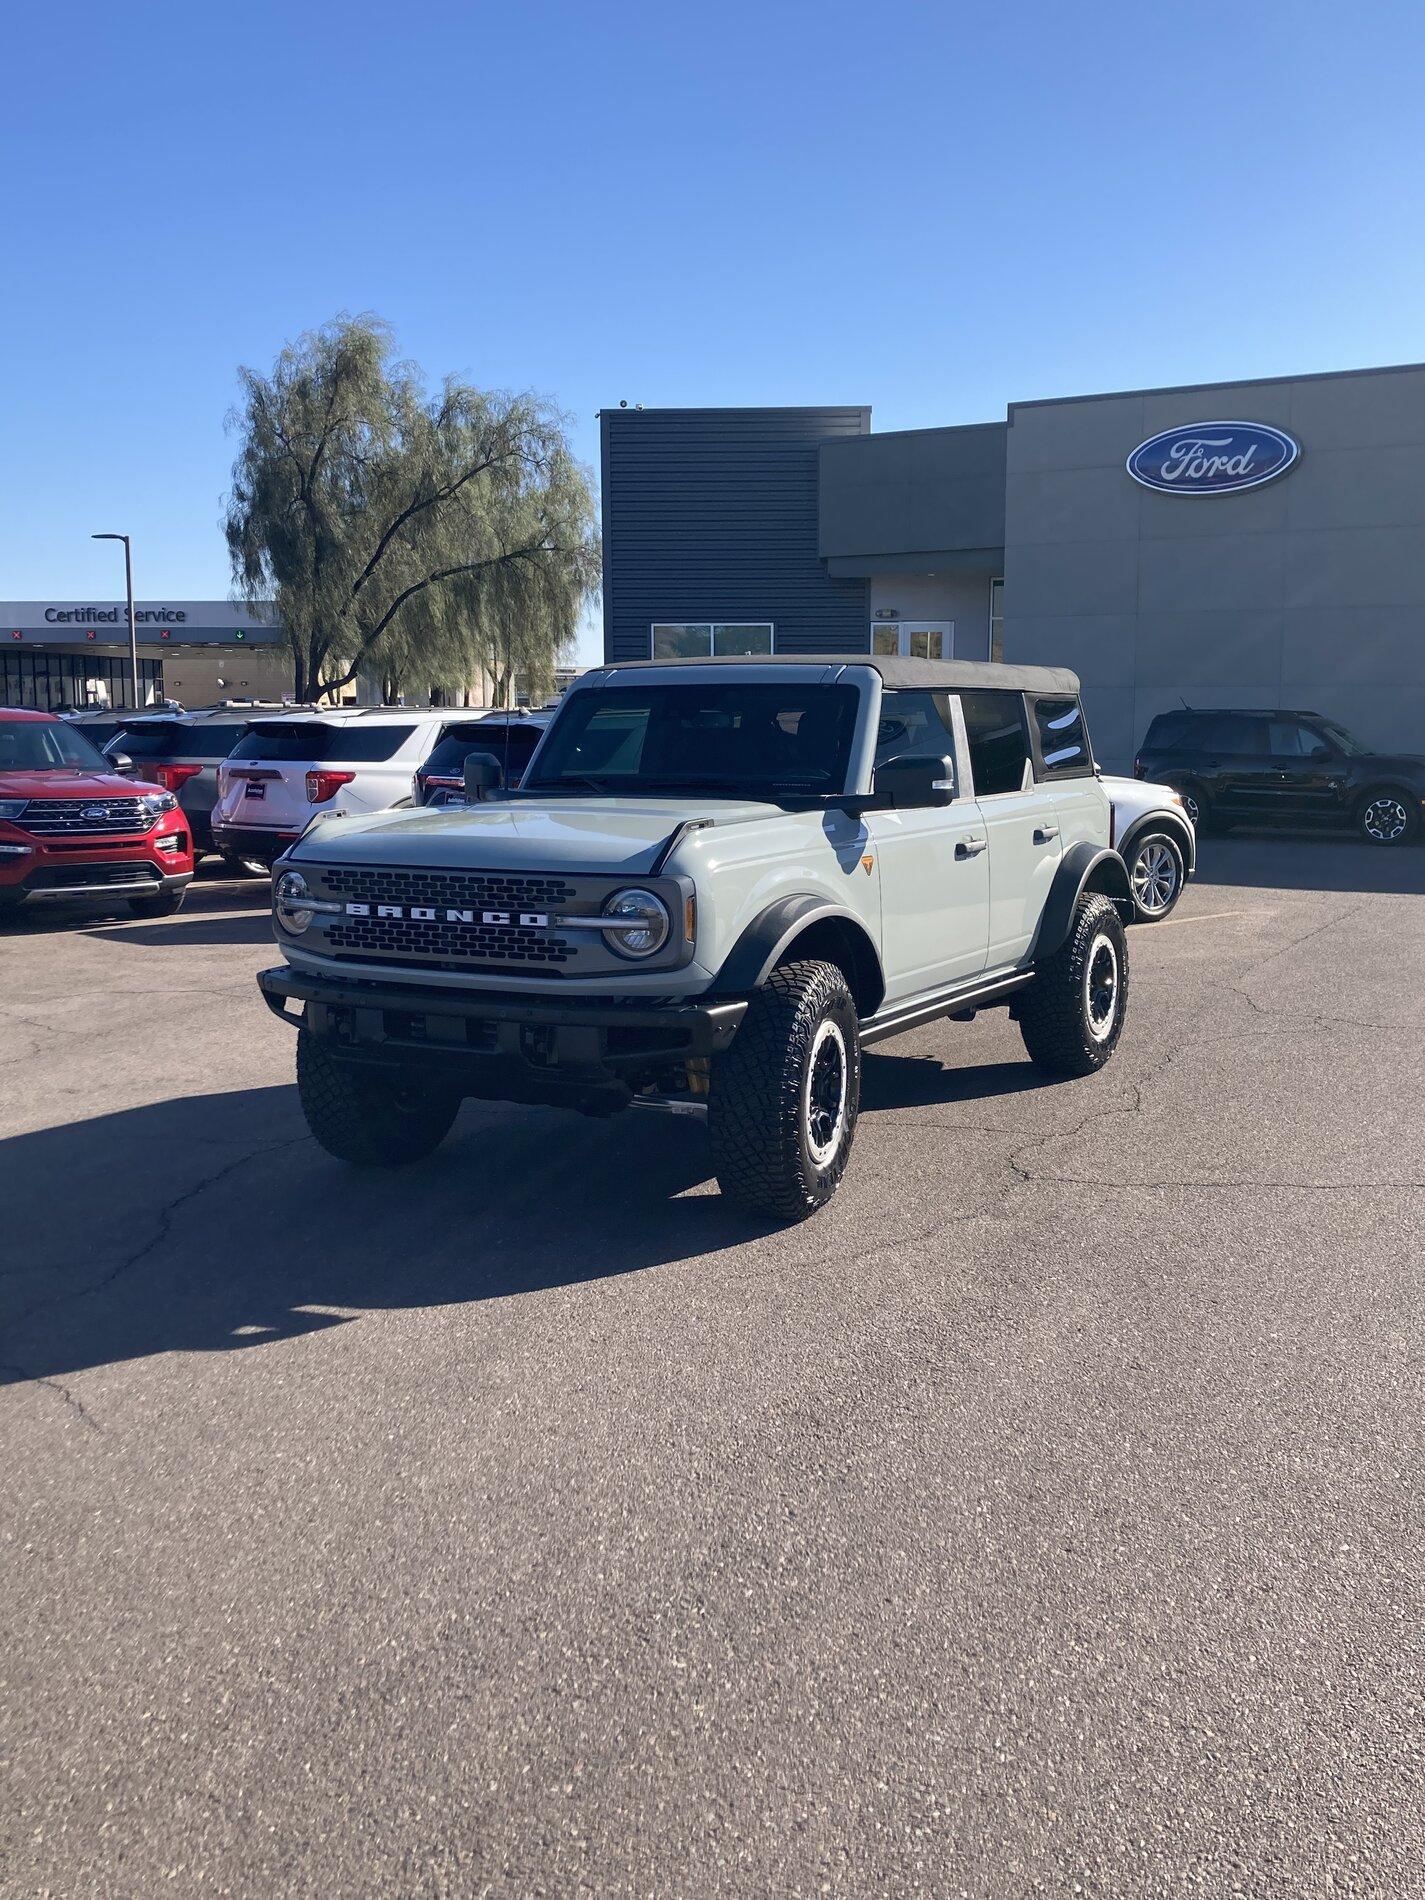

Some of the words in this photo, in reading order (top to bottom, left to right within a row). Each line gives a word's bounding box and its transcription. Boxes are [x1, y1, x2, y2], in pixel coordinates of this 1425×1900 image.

[1160, 437, 1258, 480] Ford
[44, 607, 118, 623] Certified
[346, 903, 549, 927] BRONCO
